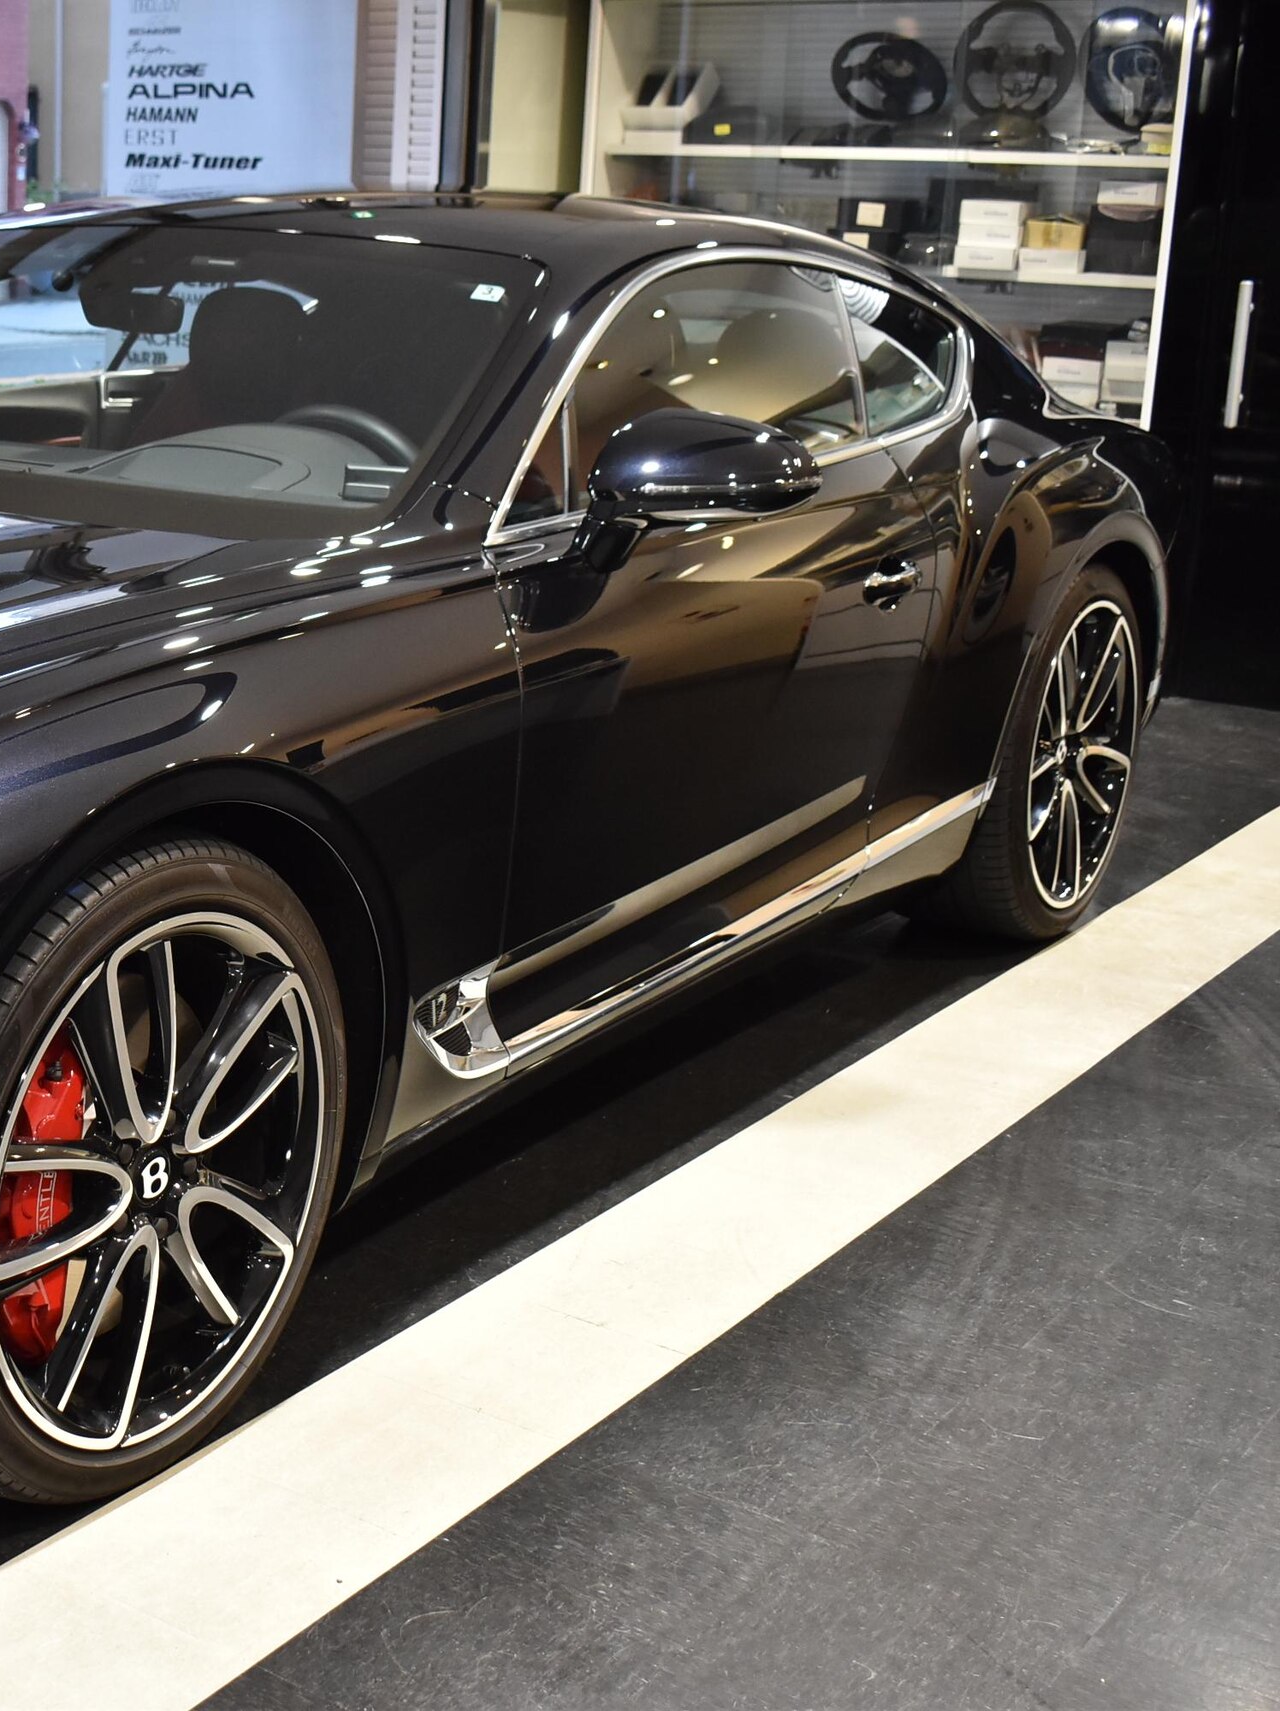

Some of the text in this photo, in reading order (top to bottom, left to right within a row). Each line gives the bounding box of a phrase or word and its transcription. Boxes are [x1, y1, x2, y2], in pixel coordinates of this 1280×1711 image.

[128, 63, 207, 78] HARTGE
[128, 83, 254, 99] ALPINA
[126, 107, 198, 122] HAMANN
[125, 153, 263, 170] Maxi-Tuner
[141, 1156, 169, 1199] B
[39, 1171, 55, 1232] ENTLE
